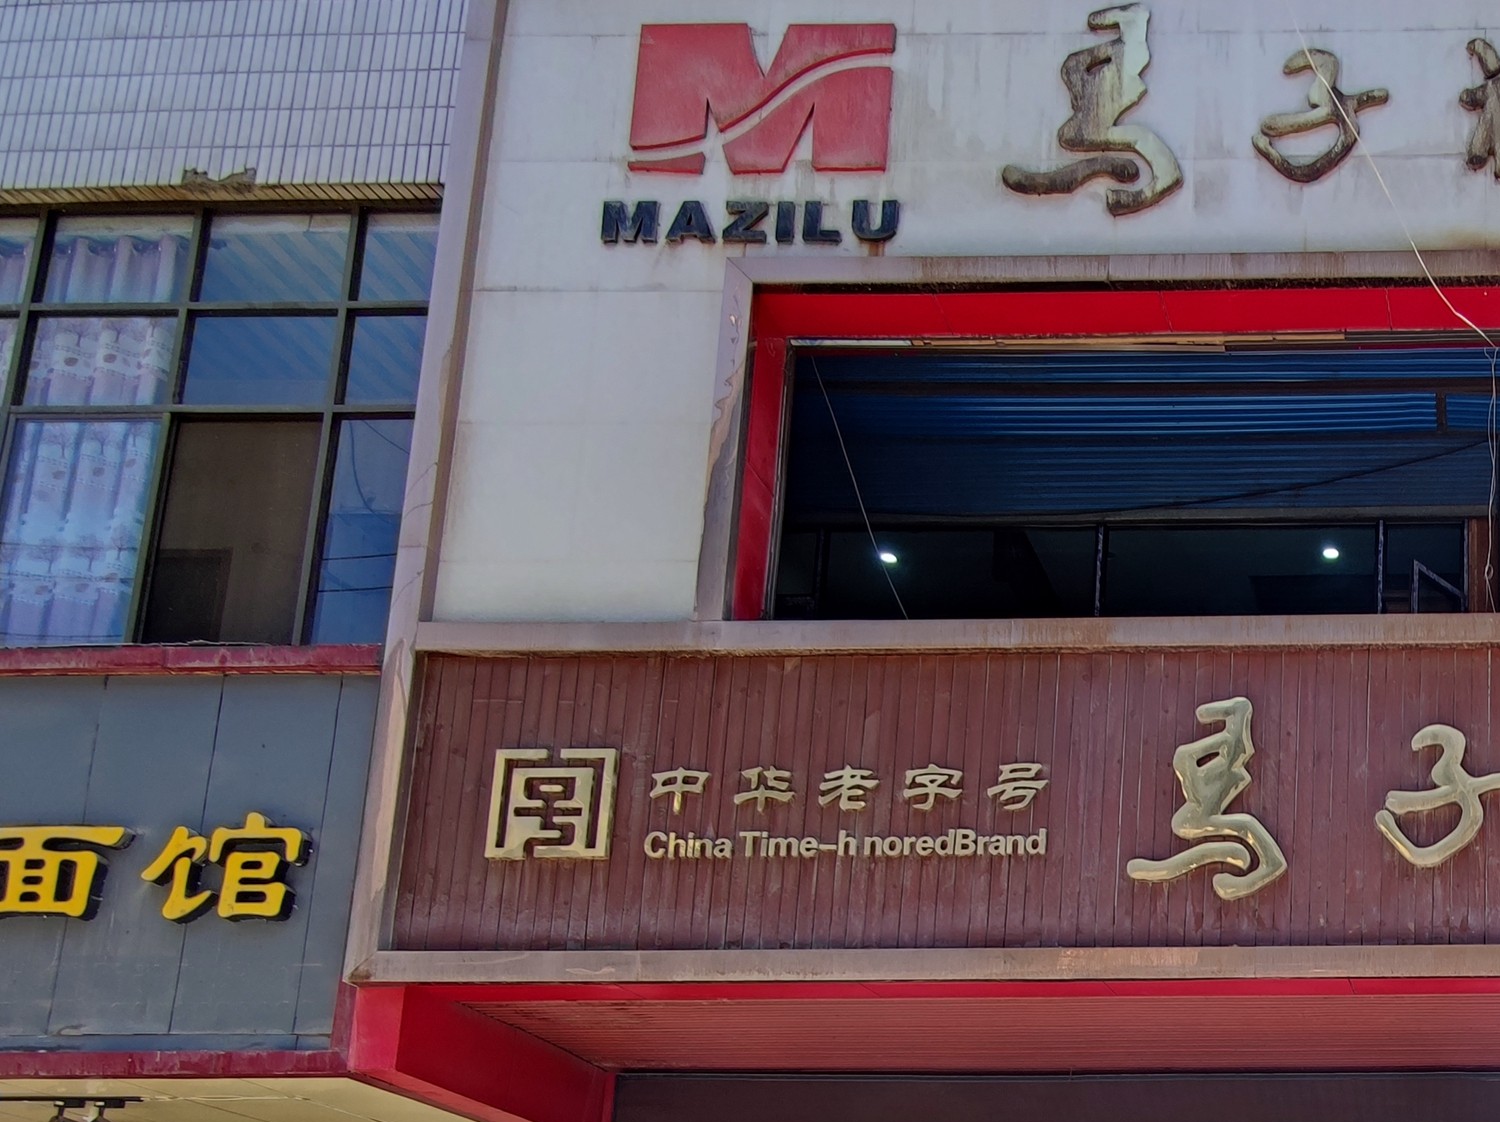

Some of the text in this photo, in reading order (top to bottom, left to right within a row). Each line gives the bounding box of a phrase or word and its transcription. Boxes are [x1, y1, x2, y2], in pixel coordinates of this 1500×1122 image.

[600, 200, 900, 246] MAZILU
[649, 762, 1050, 815] 中华老字号
[0, 813, 304, 920] 面馆
[644, 831, 733, 860] China
